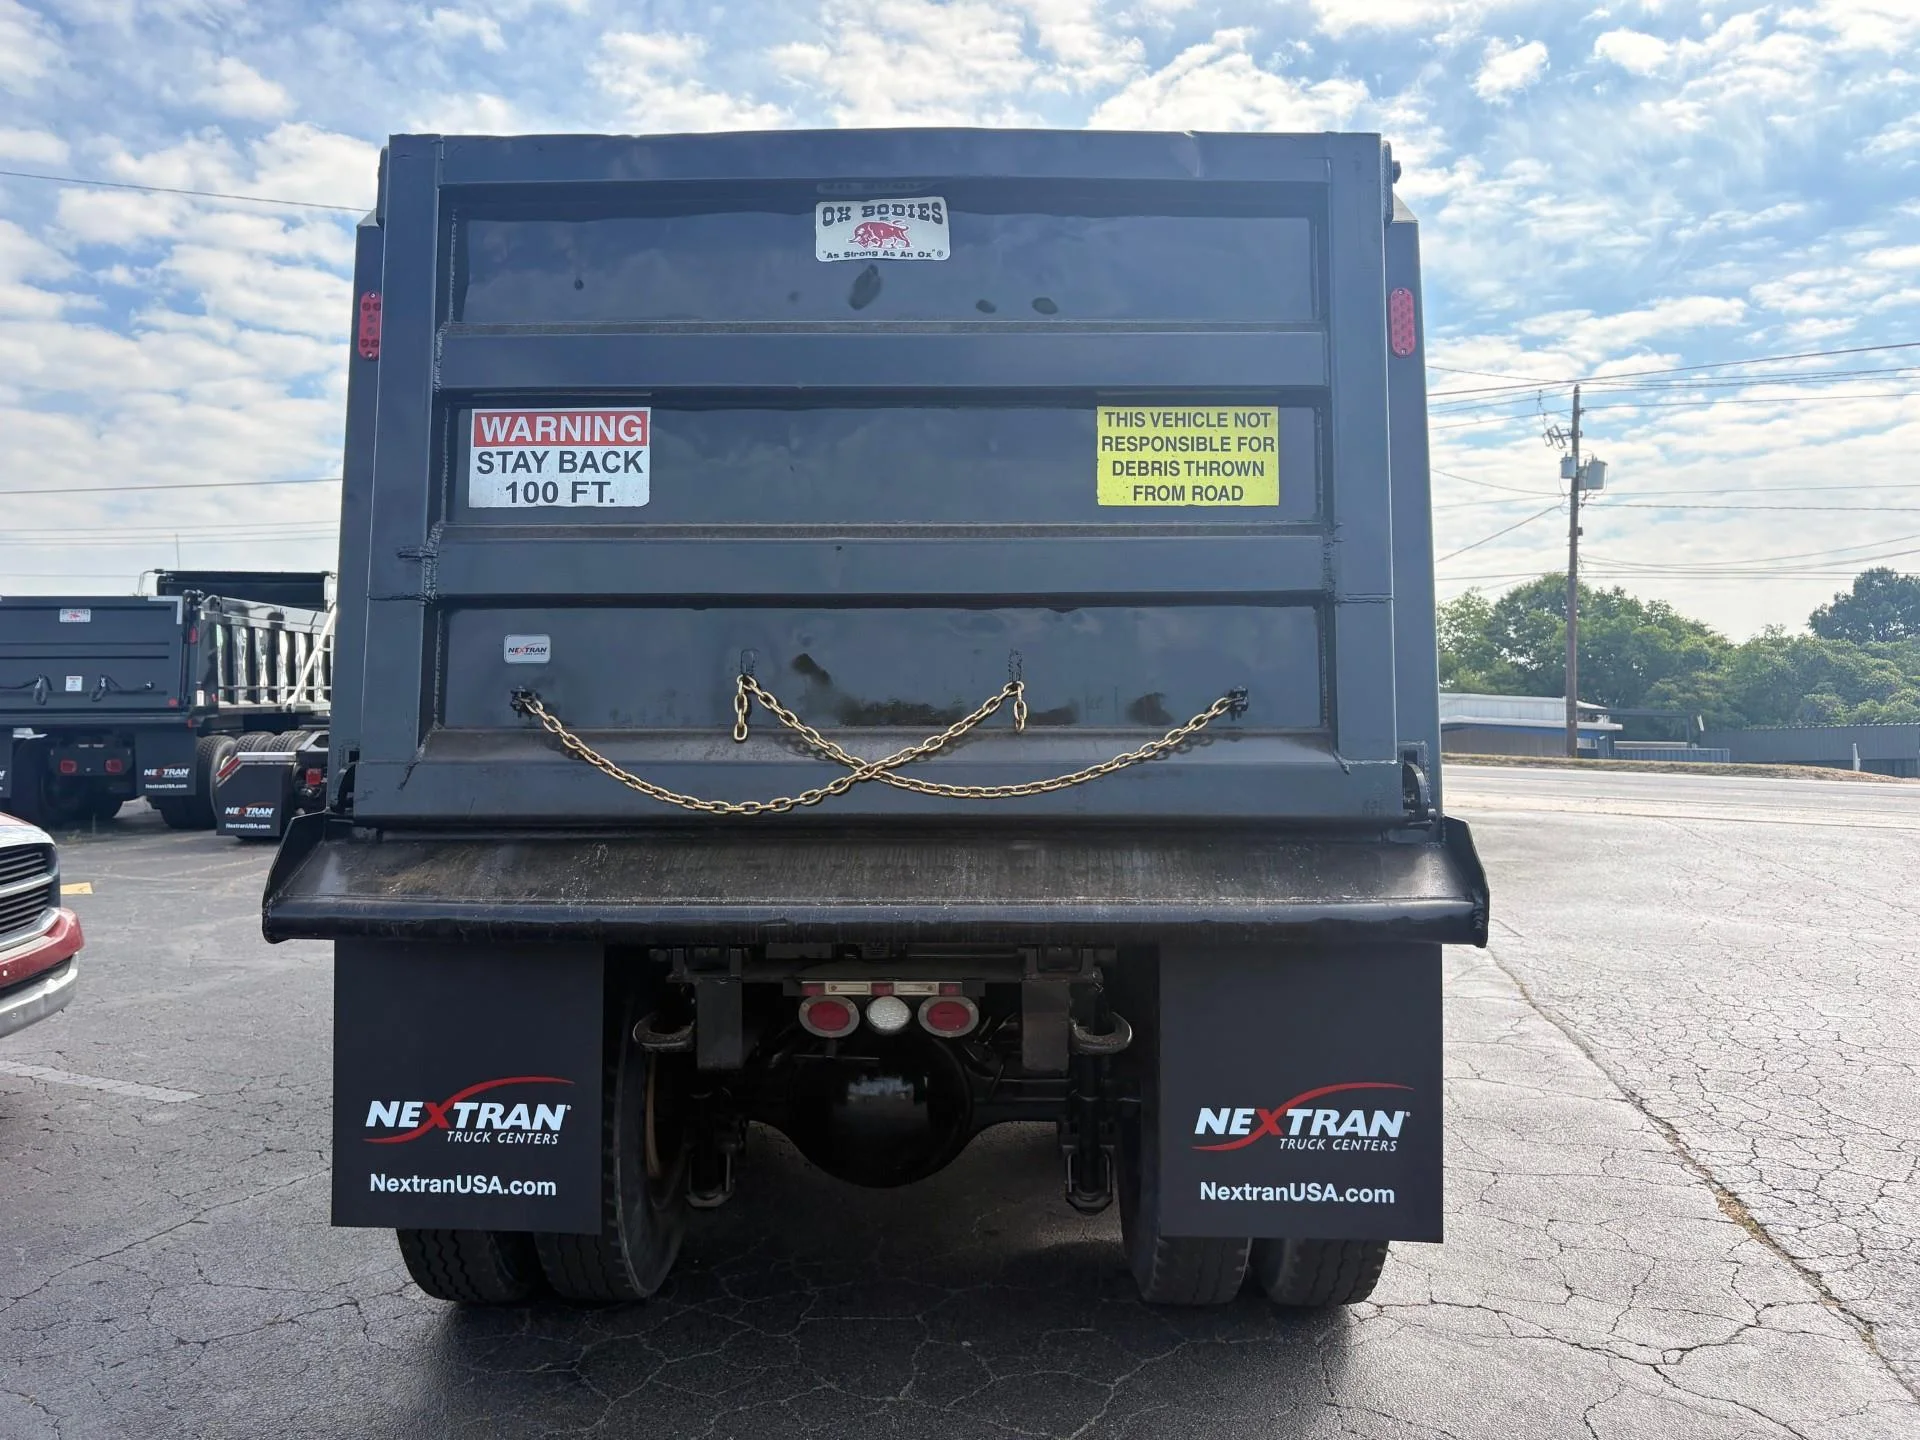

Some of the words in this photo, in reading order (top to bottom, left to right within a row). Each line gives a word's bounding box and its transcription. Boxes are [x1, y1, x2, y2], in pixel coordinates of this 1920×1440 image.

[822, 206, 851, 226] OX
[861, 202, 943, 225] BODIES
[843, 250, 878, 258] Strong
[480, 415, 642, 443] WARNING
[1104, 412, 1146, 428] THIS
[1150, 412, 1228, 428] VEHICLE
[1234, 412, 1271, 428] NOT
[1102, 436, 1231, 452] RESPONSIBLE
[1237, 436, 1275, 452] FOR
[476, 450, 550, 474] STAY
[558, 450, 643, 474] BACK
[1112, 460, 1181, 477] DEBRIS
[1184, 460, 1264, 477] THROWN
[505, 481, 559, 504] 100
[571, 481, 615, 504] FT.
[1133, 485, 1186, 501] FROM
[1191, 485, 1244, 501] ROAD
[225, 807, 274, 815] NEXTRAN
[365, 1100, 567, 1131] NEXTRAN
[1195, 1107, 1405, 1138] NEXTRAN
[447, 1130, 491, 1144] TRUCK
[497, 1132, 559, 1145] CENTERS
[1279, 1138, 1326, 1150] TRUCK
[1332, 1139, 1398, 1152] CENTERS
[370, 1173, 557, 1196] NextranUSA.com
[1200, 1181, 1396, 1204] NextranUSA.com
